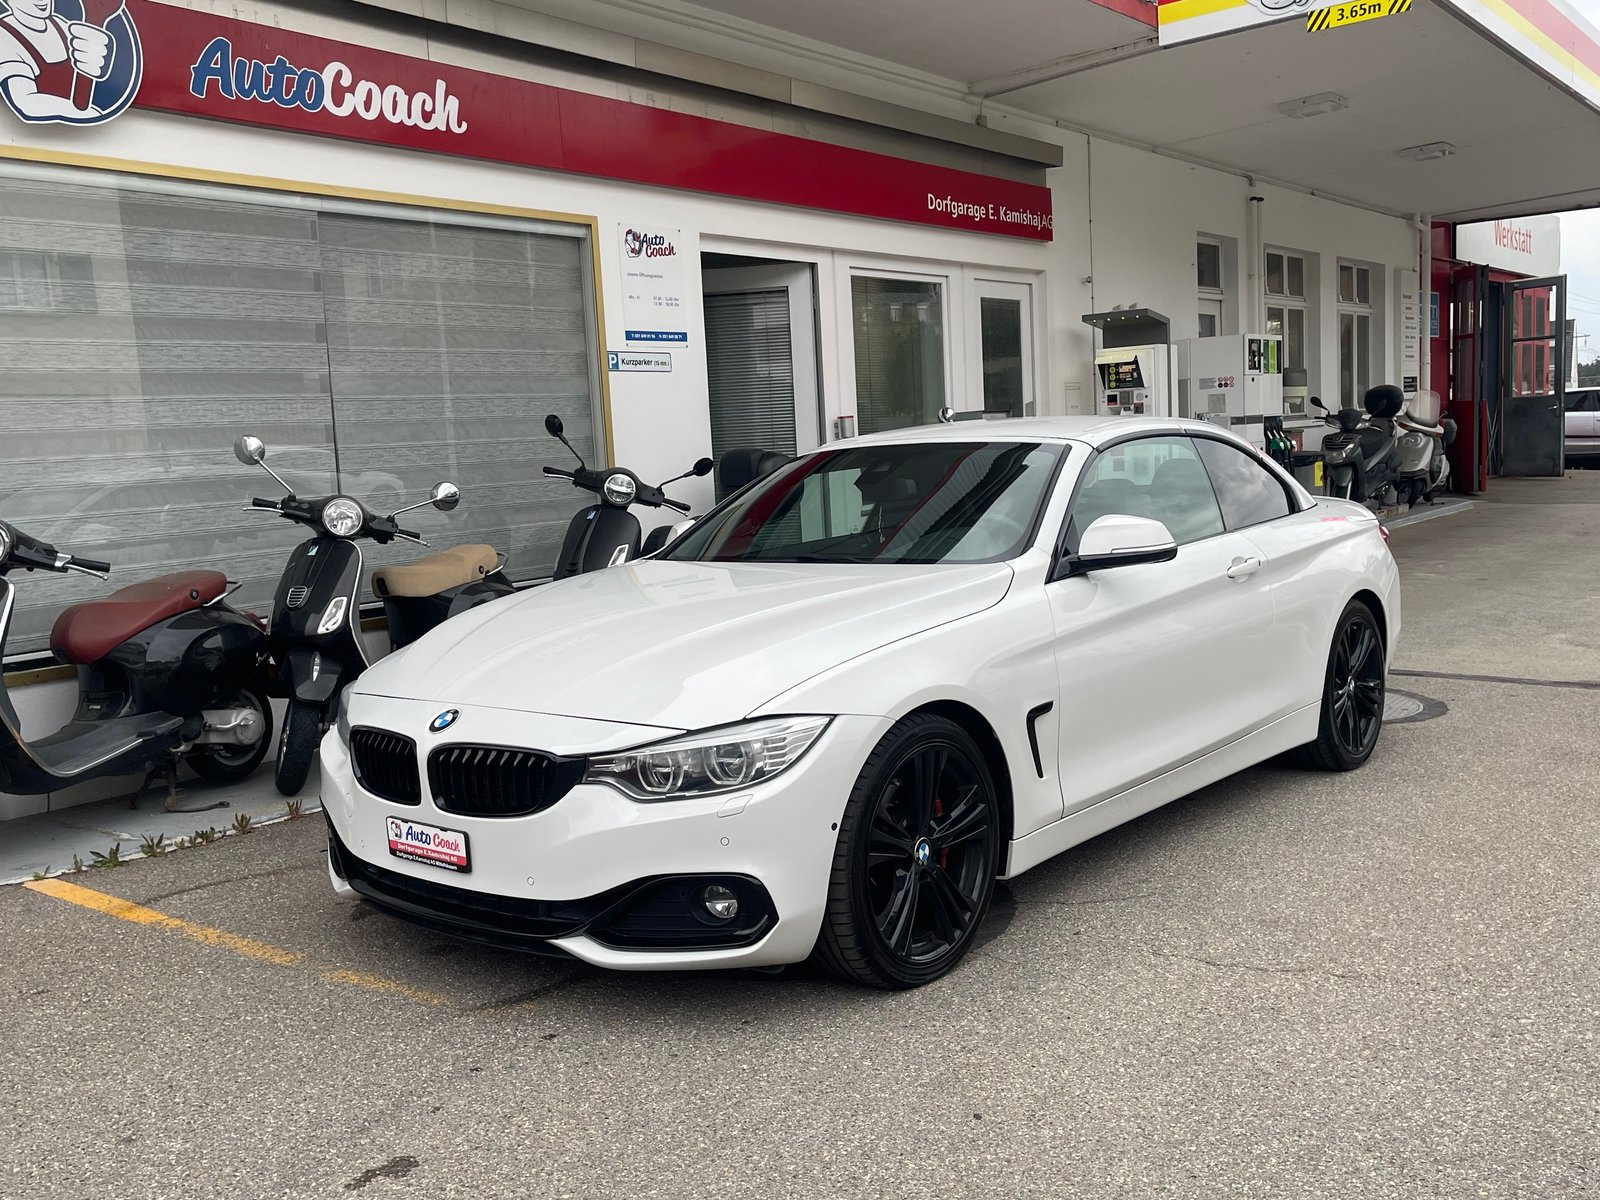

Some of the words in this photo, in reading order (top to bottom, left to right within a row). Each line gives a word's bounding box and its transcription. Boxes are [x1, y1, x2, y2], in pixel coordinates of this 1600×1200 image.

[1336, 2, 1382, 21] 3.65m
[927, 193, 986, 221] Dorfgarage
[988, 204, 997, 220] E.
[642, 233, 665, 248] Auto
[1494, 219, 1532, 254] Werkstatt
[645, 242, 676, 258] Coach
[621, 358, 652, 367] Kurzparker
[406, 825, 431, 845] Auto
[432, 833, 460, 852] Coach
[397, 843, 423, 855] Dorfgarage
